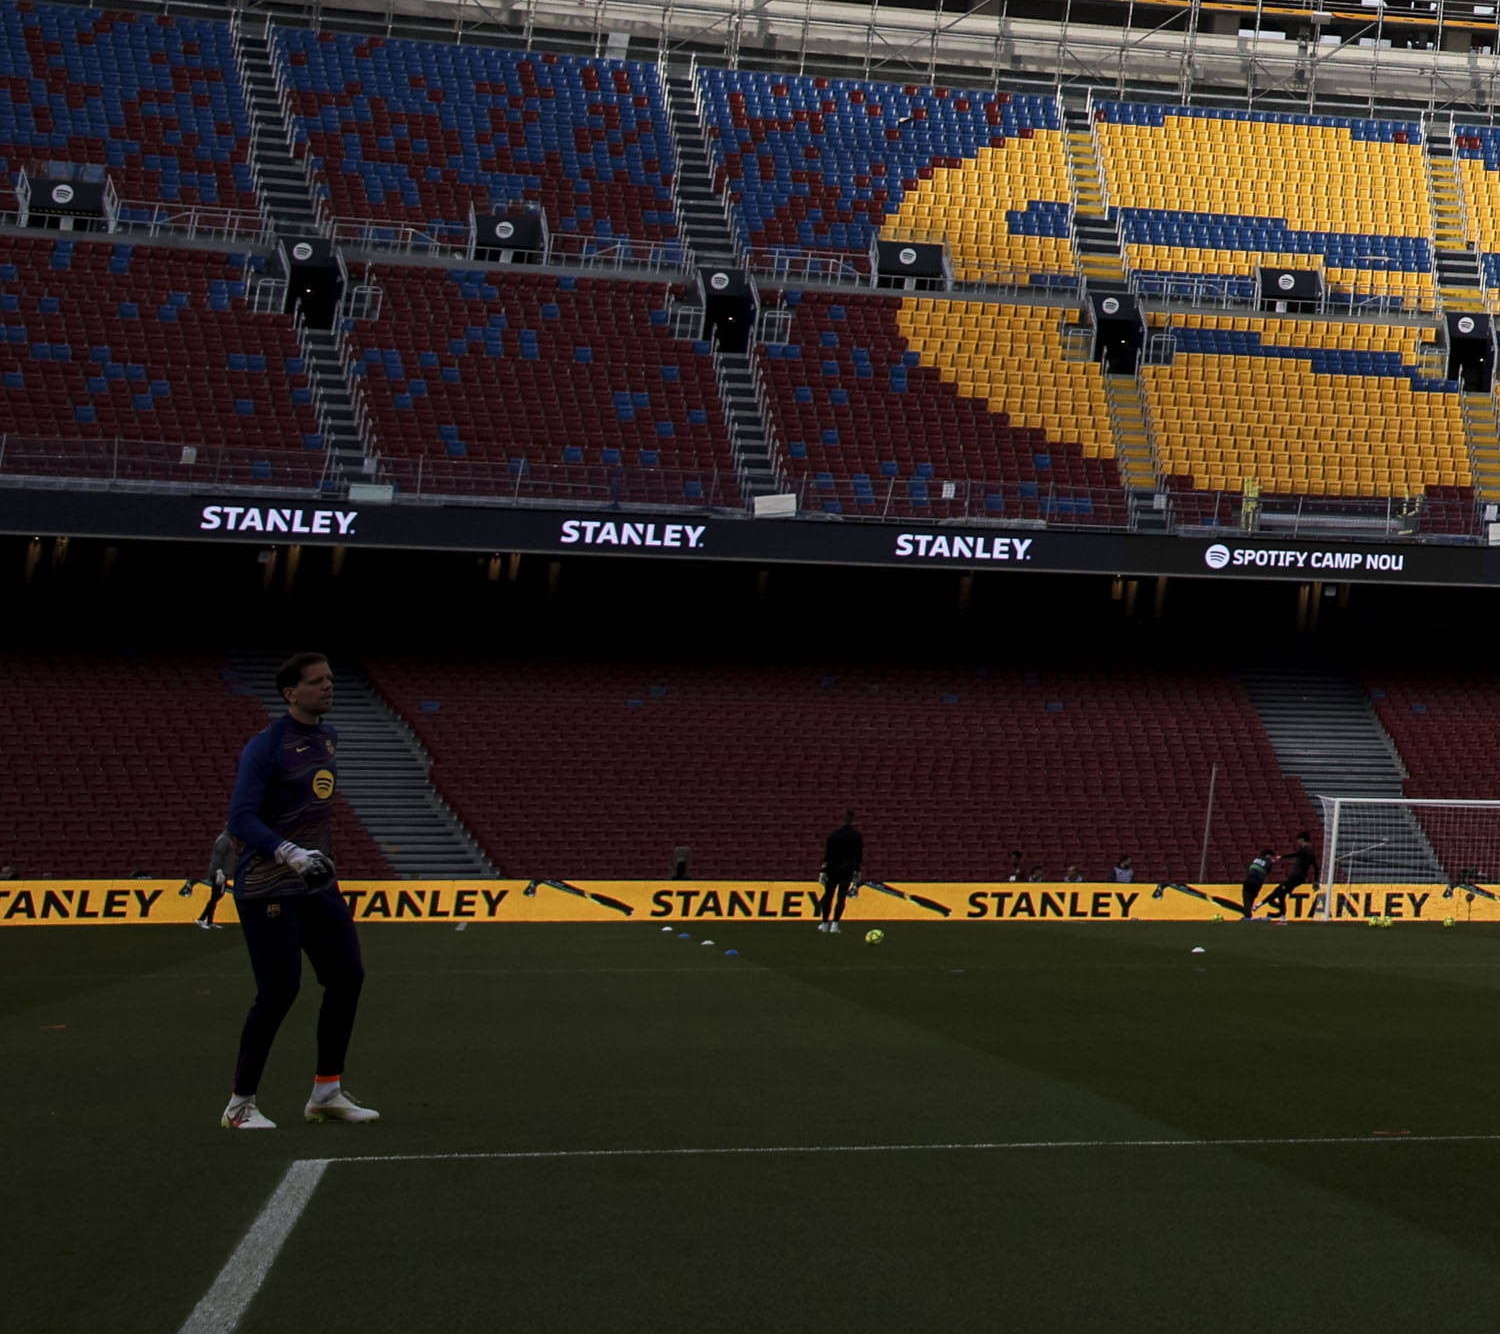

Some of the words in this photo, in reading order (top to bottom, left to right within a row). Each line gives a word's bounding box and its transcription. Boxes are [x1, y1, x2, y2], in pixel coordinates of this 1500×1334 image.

[1233, 550, 1306, 566] SPOTIFY
[1311, 552, 1362, 568] CAMP
[1366, 555, 1403, 570] NOU
[0, 890, 163, 919] ANLEY
[342, 890, 509, 918] TANLEY
[968, 892, 1138, 918] STANLEY
